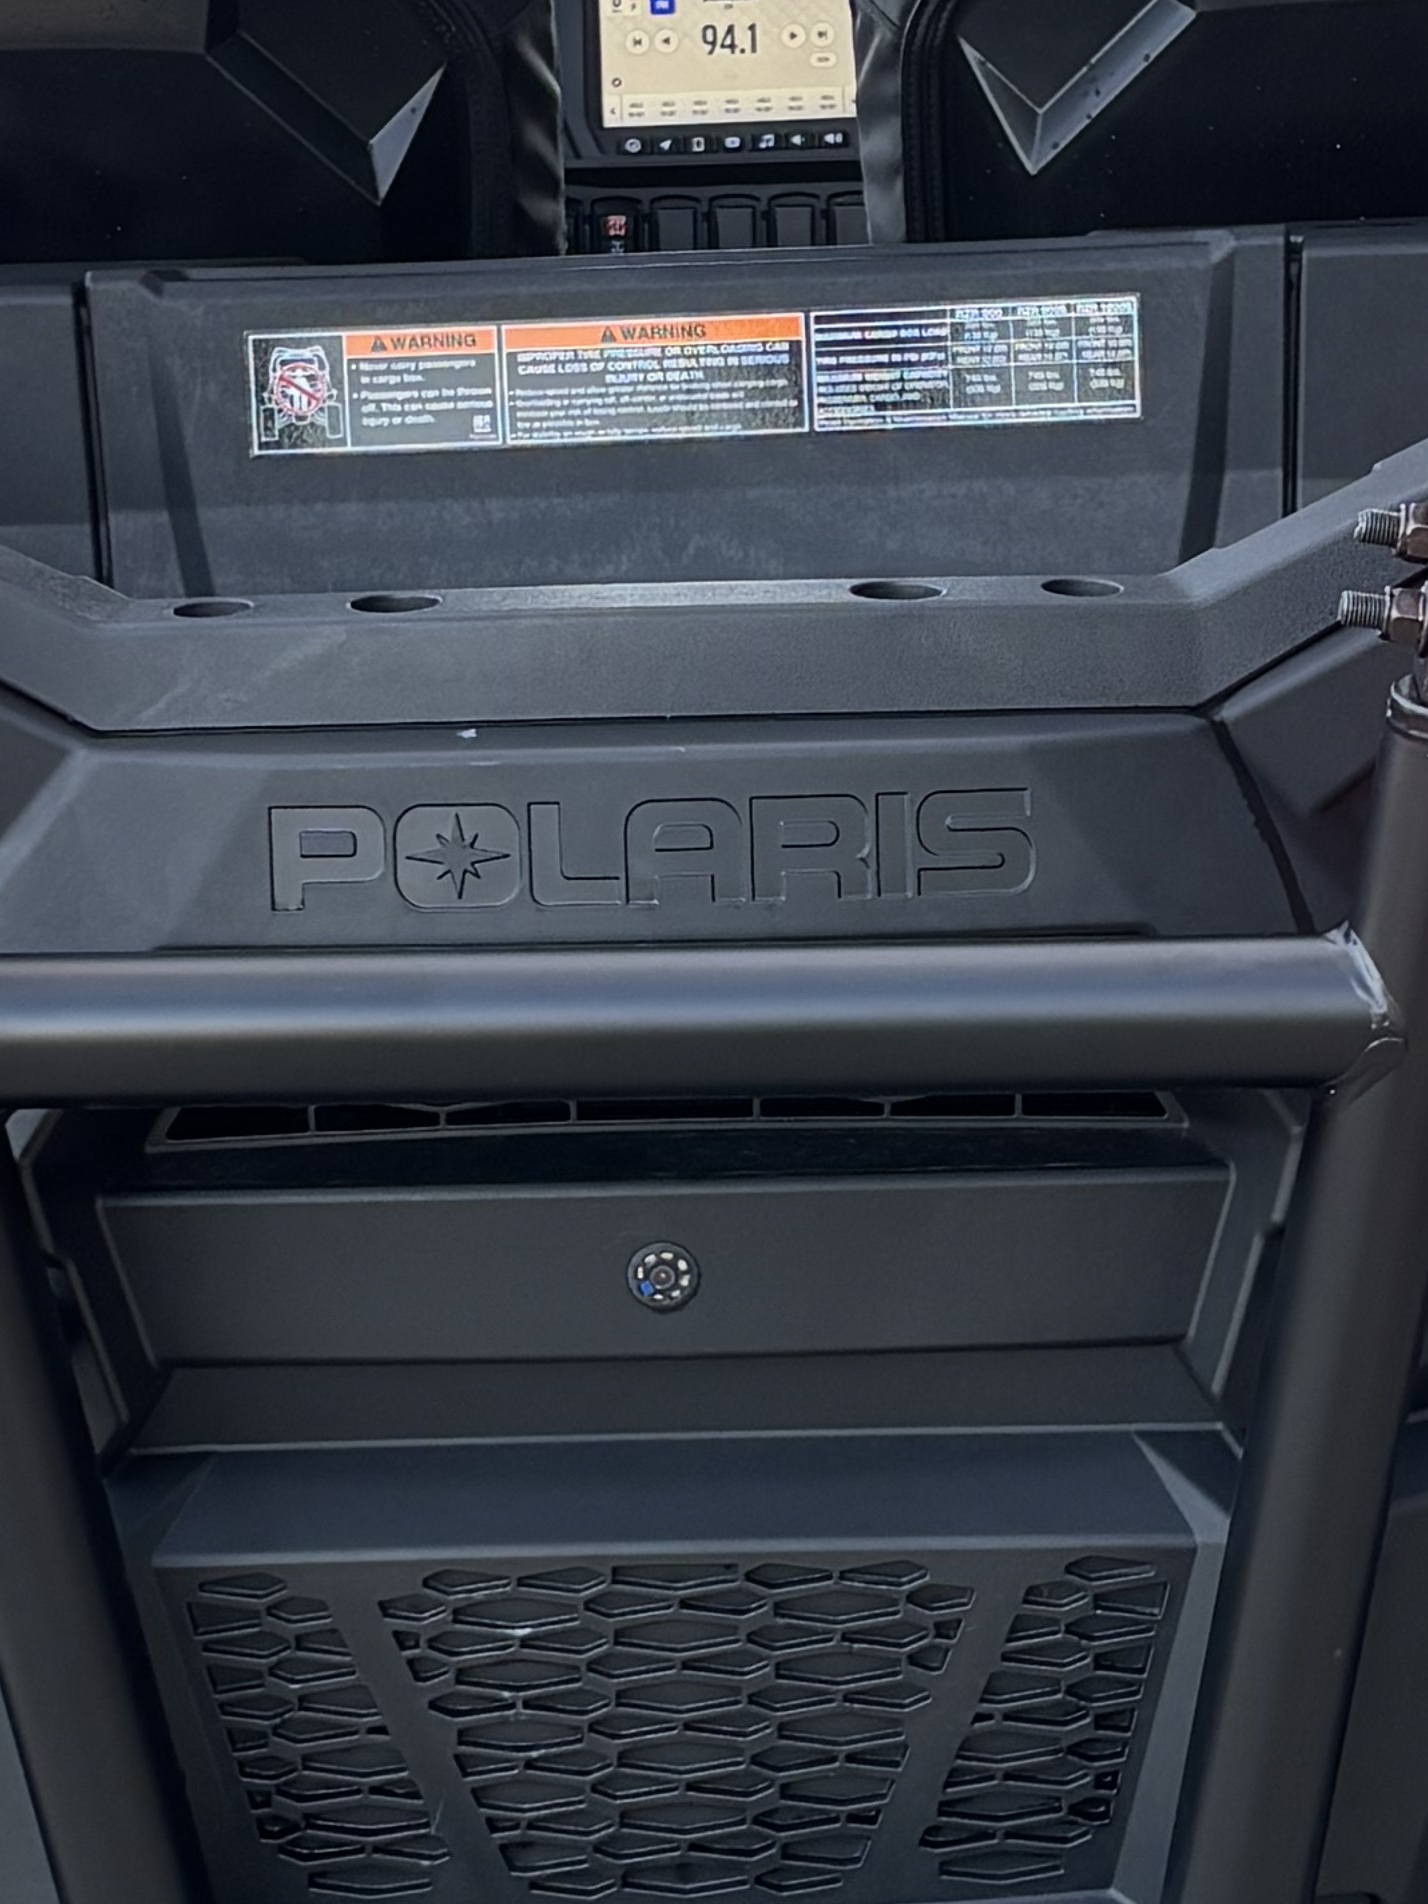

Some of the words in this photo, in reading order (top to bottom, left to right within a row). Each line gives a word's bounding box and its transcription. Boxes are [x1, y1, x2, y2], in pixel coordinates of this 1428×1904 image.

[701, 22, 757, 55] 94.1
[391, 334, 477, 351] WARNING
[620, 323, 707, 341] WARNING
[267, 787, 1037, 913] POLARIS
